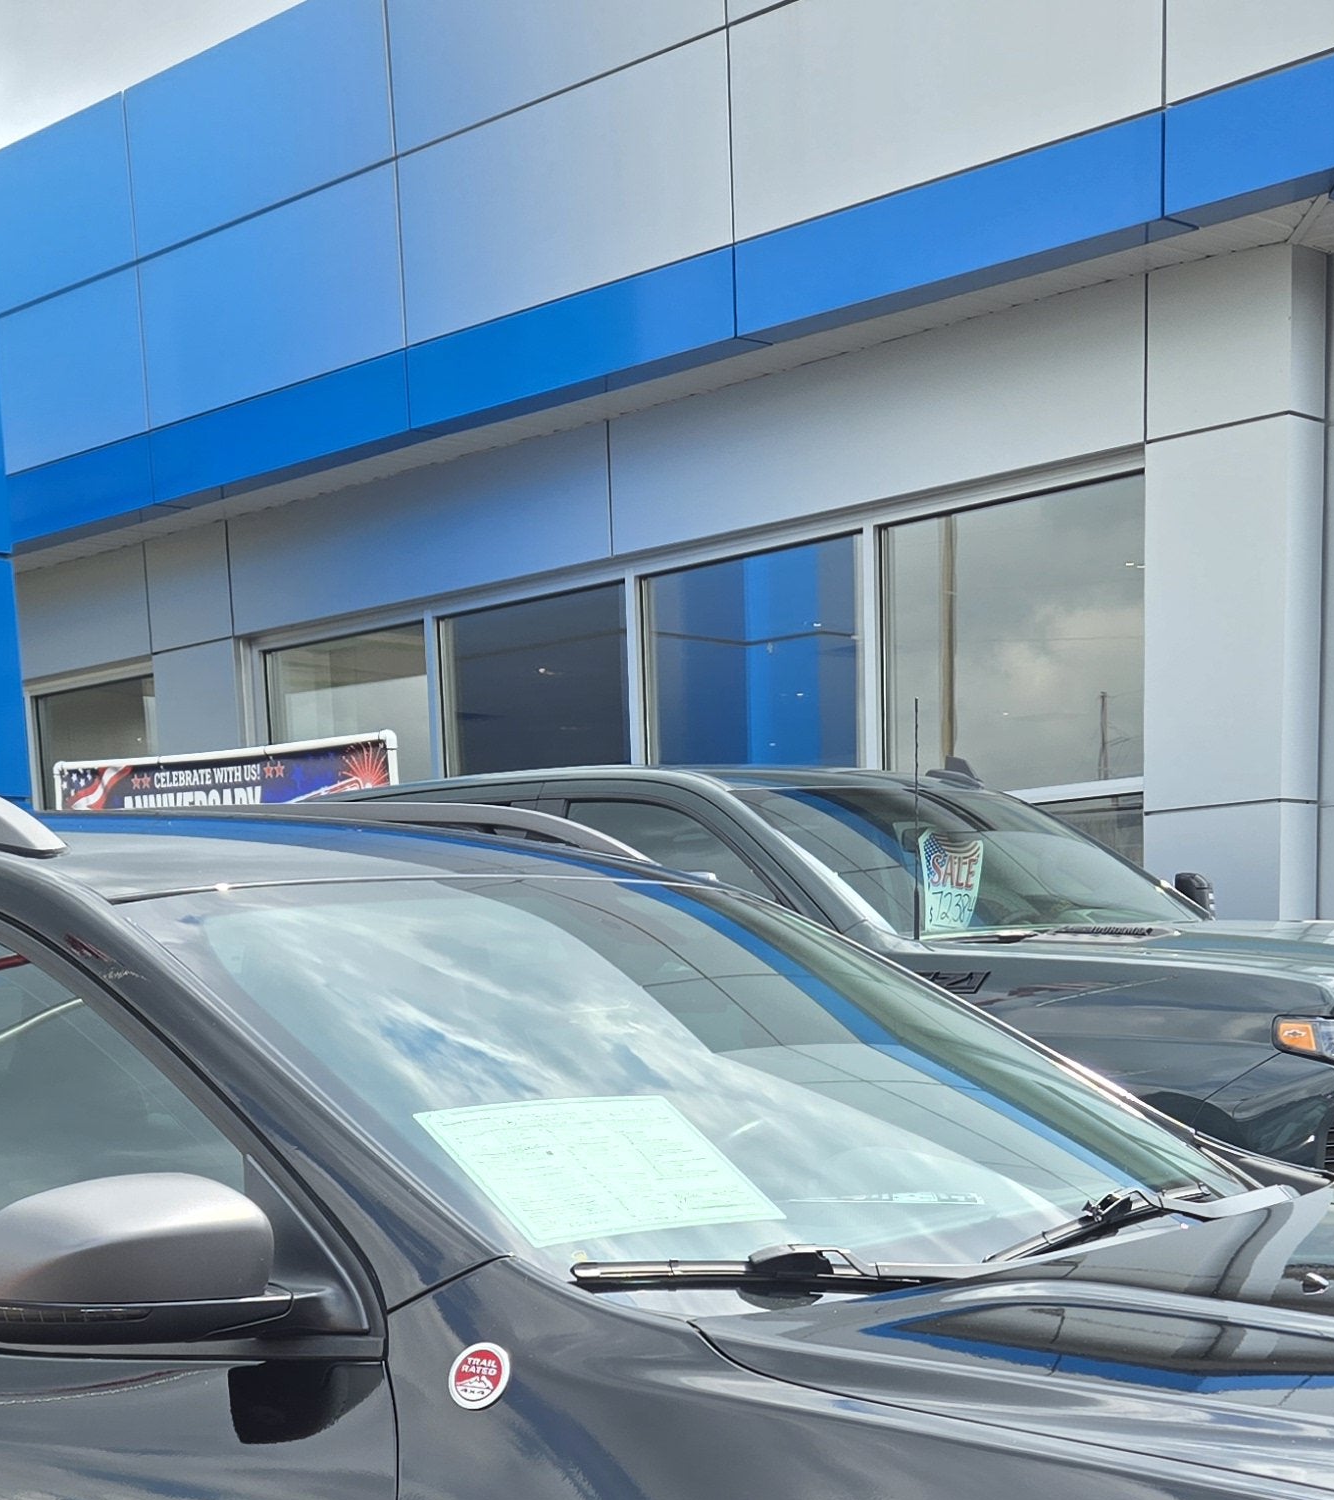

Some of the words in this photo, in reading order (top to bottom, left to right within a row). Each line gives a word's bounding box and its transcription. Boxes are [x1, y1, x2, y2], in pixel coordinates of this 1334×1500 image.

[154, 768, 212, 789] CELEBRATE
[213, 765, 242, 784] WITH
[243, 763, 261, 781] US!
[930, 853, 978, 890] SALE
[461, 1364, 498, 1376] RATED
[467, 1357, 497, 1368] TRAIL
